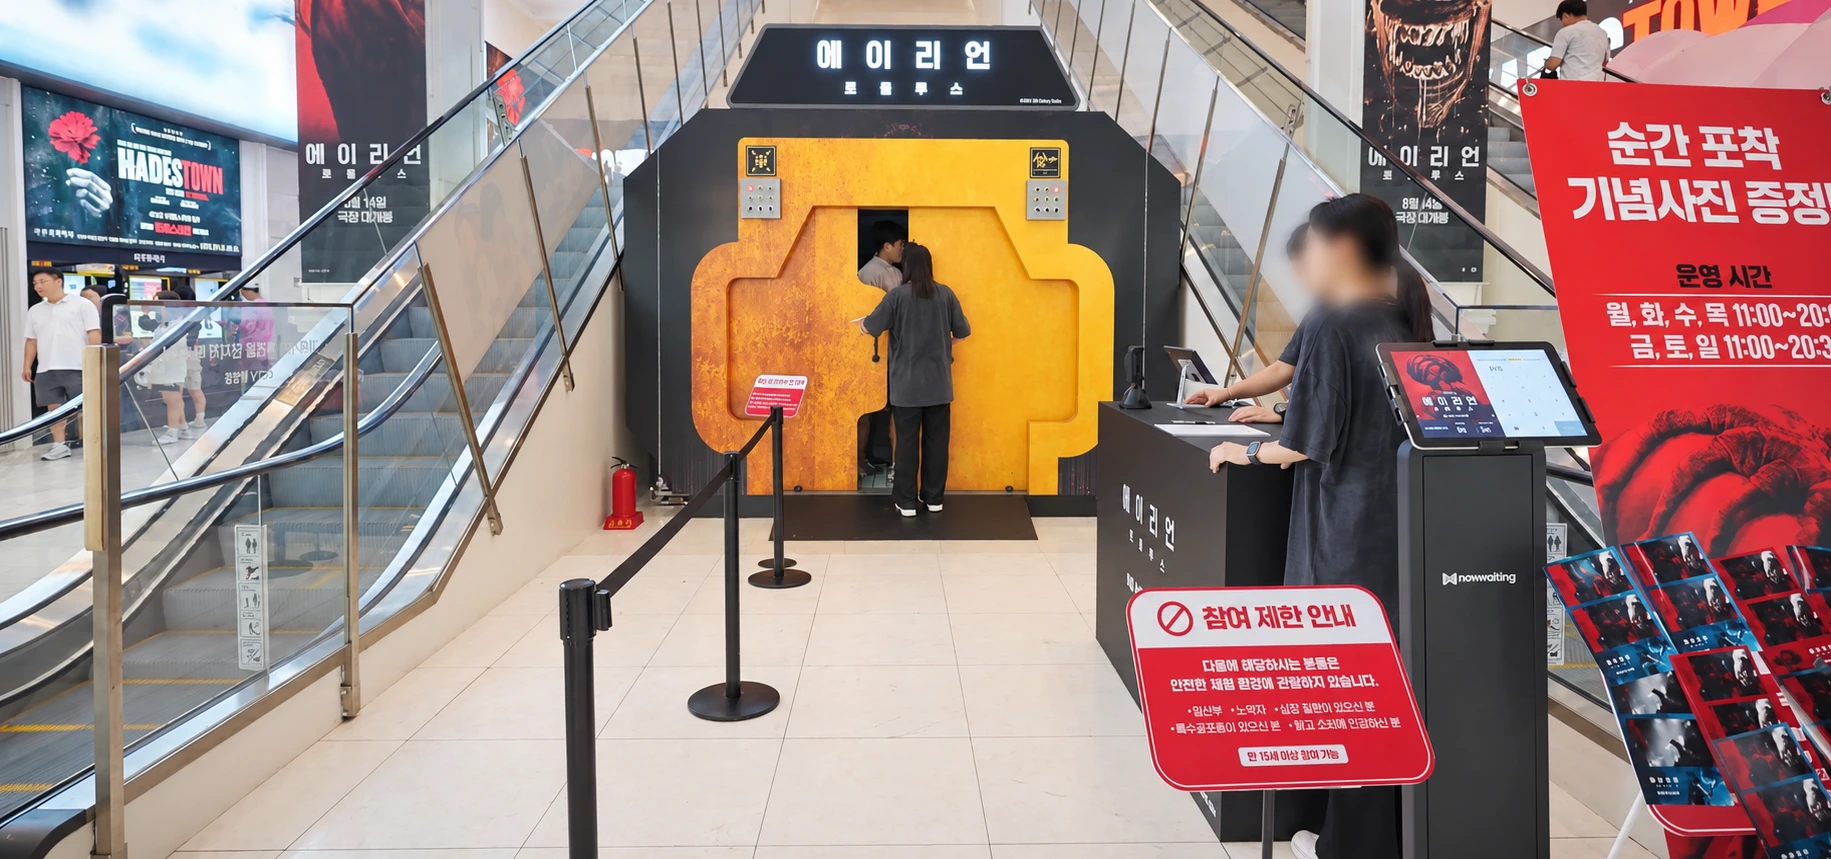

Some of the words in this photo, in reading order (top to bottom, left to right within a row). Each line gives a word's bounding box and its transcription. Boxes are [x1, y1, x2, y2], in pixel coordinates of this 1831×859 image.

[1607, 122, 1692, 168] 순간
[1698, 125, 1782, 170] 포착
[117, 146, 224, 195] HADESTOWN
[1402, 197, 1419, 210] 8월
[1567, 176, 1740, 223] 기념사진
[337, 211, 359, 223] 극장
[1395, 211, 1417, 224] 극장
[1676, 263, 1721, 289] 운영
[1729, 265, 1773, 289] 시간
[1606, 302, 1637, 328] 월,
[1640, 302, 1670, 328] 화,
[1674, 302, 1703, 328] 수,
[1705, 302, 1729, 327] 목
[1732, 303, 1831, 327] 11:00~20:
[1630, 334, 1660, 360] 금,
[1663, 334, 1693, 360] 토,
[1696, 334, 1720, 359] 일
[1458, 572, 1516, 584] nowwaiting
[1202, 606, 1252, 630] 참여
[1254, 605, 1304, 629] 제한
[1306, 604, 1357, 628] 안내
[1202, 659, 1239, 673] 다음에
[1241, 658, 1301, 672] 해당하시는
[1170, 678, 1208, 692] 안전한
[1327, 673, 1379, 689] 있습니다.
[1258, 750, 1279, 762] 15세
[1280, 749, 1300, 761] 이상
